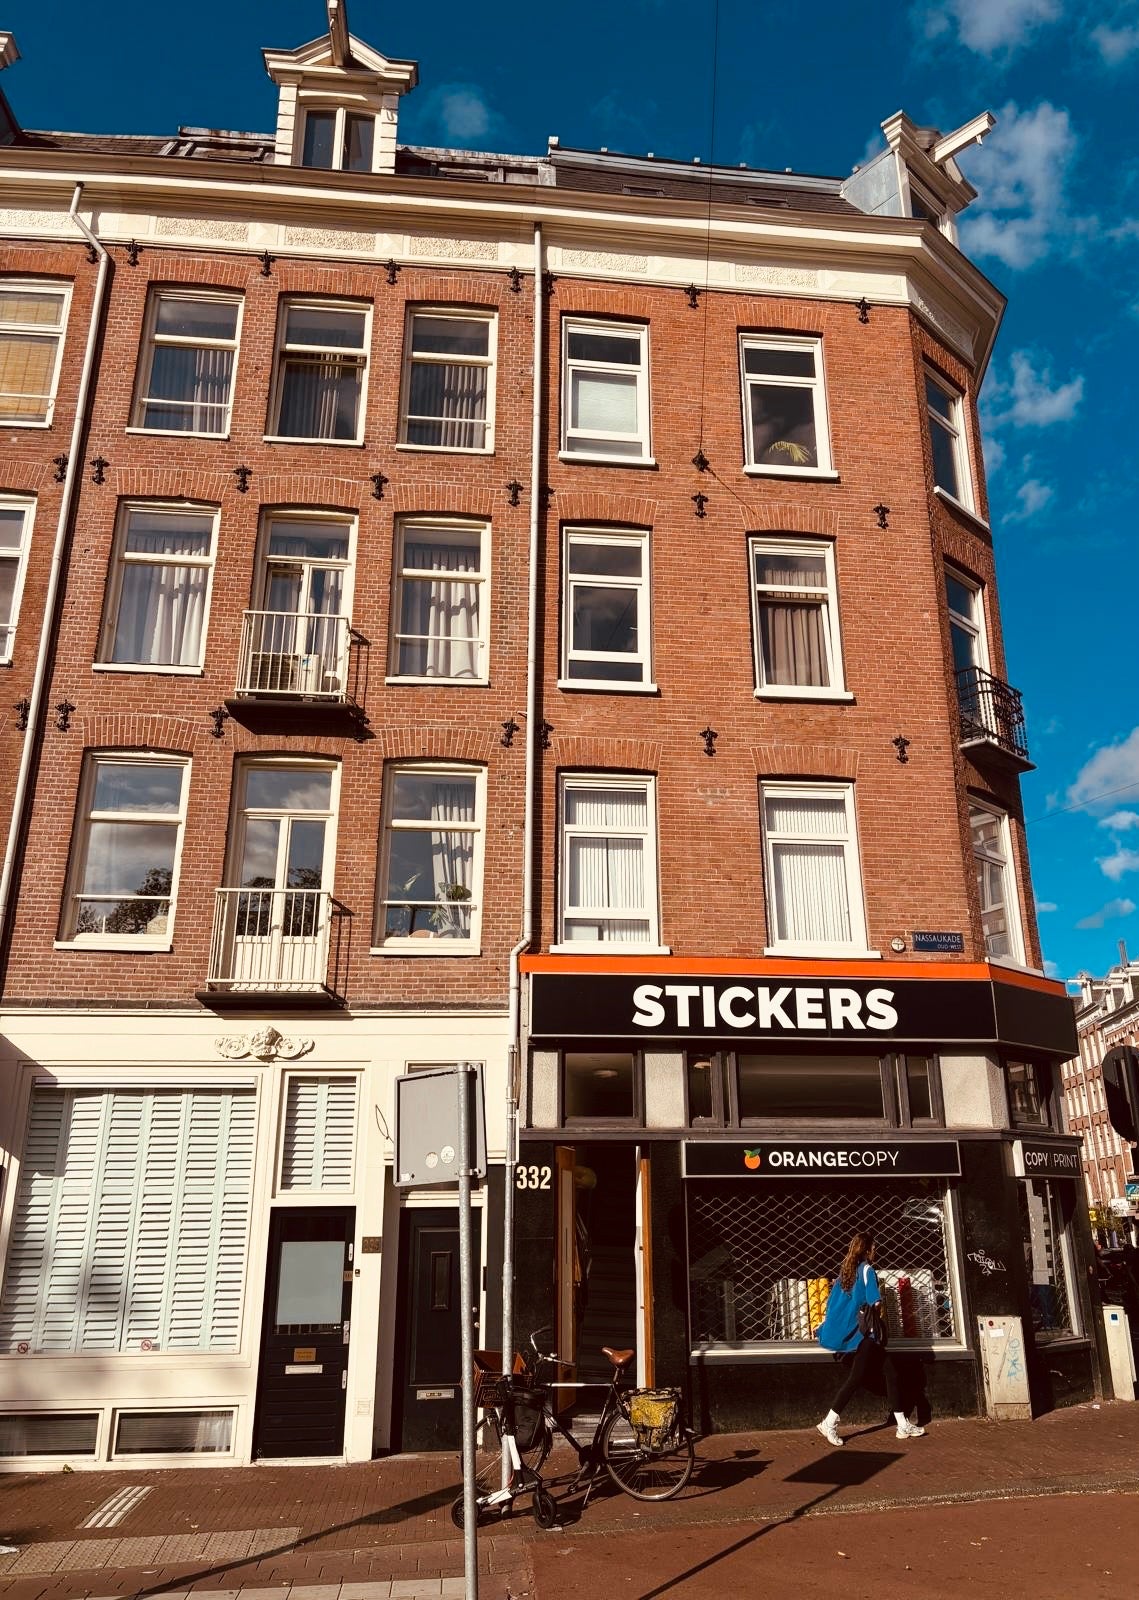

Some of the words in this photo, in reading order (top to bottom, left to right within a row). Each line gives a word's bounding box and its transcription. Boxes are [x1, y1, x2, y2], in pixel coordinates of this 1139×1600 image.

[915, 934, 961, 943] NASSAUKADE
[631, 984, 898, 1030] STICKERS
[768, 1150, 900, 1167] ORANGECOPY
[1025, 1151, 1048, 1167] COPY
[1053, 1153, 1077, 1169] PRINT
[516, 1165, 552, 1190] 332
